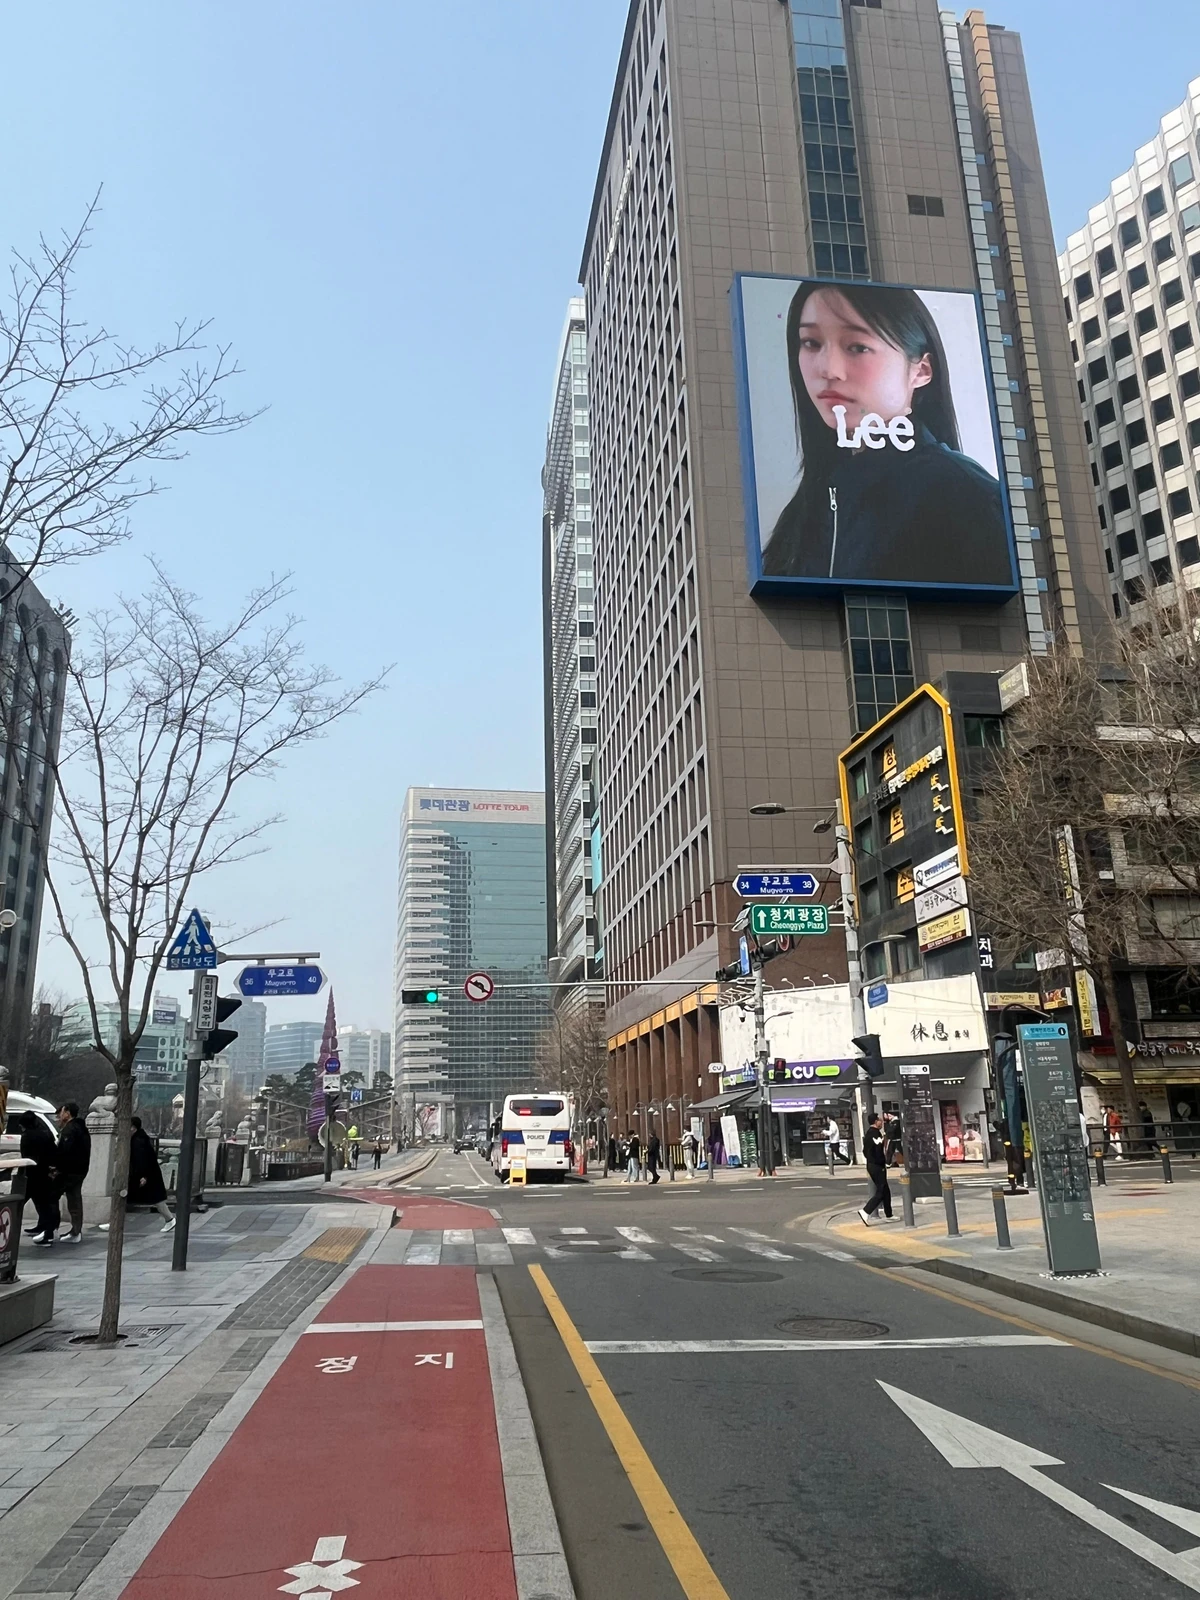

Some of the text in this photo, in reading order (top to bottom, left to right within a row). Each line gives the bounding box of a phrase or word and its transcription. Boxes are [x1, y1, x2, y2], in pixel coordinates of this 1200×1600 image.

[832, 404, 915, 451] Lee
[419, 799, 470, 812] 롯데관광
[473, 803, 502, 811] LOTTE
[740, 881, 750, 889] 34
[761, 876, 791, 886] 무교로
[802, 881, 812, 889] 38
[770, 908, 824, 921] 청계광장
[770, 921, 805, 931] Cheonggye
[978, 938, 993, 968] 치과
[268, 969, 295, 978] 무교로
[911, 1020, 948, 1042] 休息
[792, 1066, 814, 1079] CU
[315, 1352, 454, 1374] 정지
